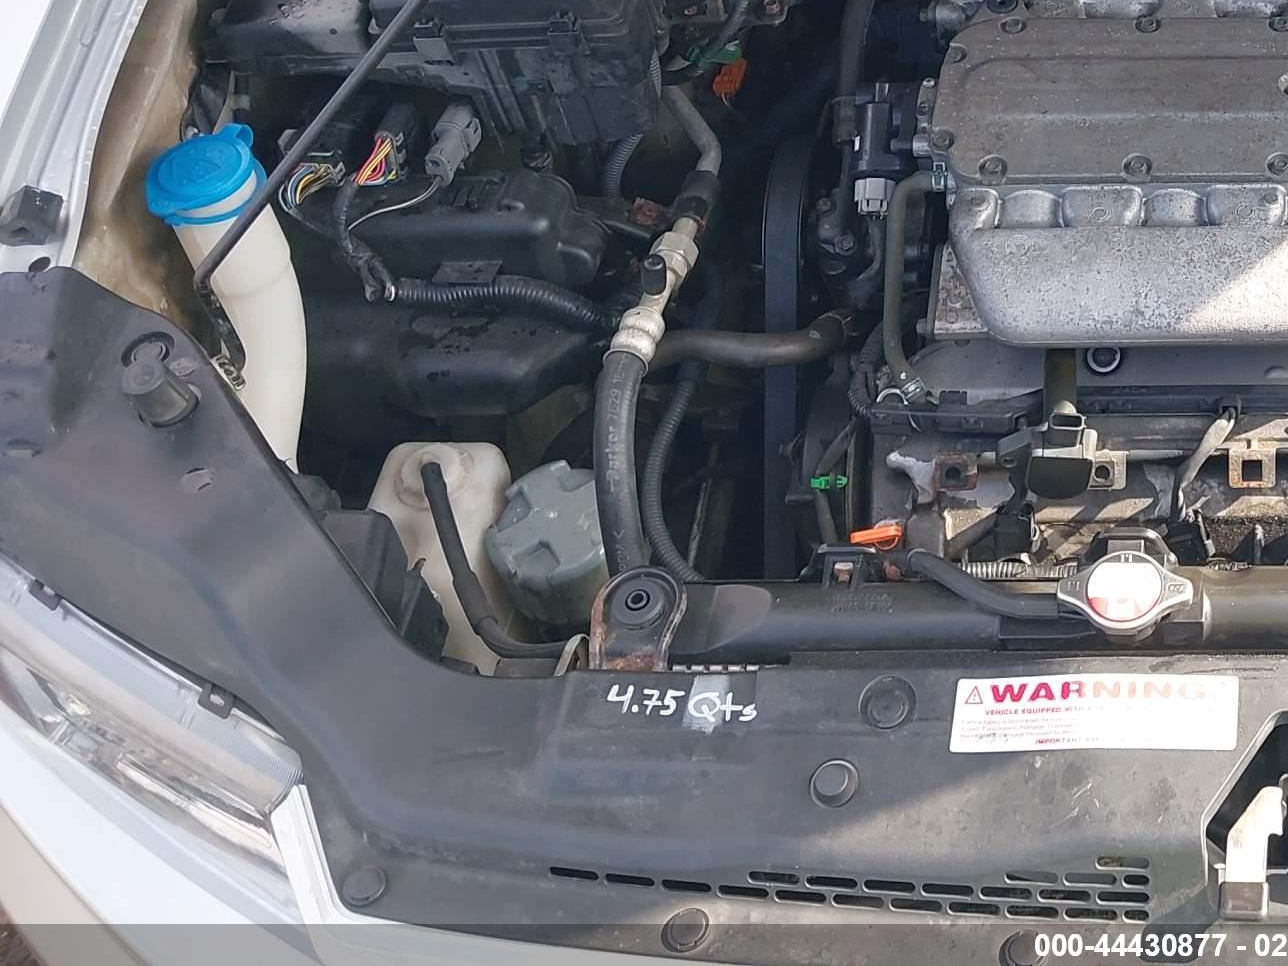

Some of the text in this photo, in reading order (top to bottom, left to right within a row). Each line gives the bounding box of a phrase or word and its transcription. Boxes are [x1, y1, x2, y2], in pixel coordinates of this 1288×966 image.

[990, 680, 1209, 704] WARNING
[607, 684, 758, 722] 4.75 Qts
[1021, 707, 1062, 715] EQUIPPED
[1035, 737, 1082, 746] IMPORTANT
